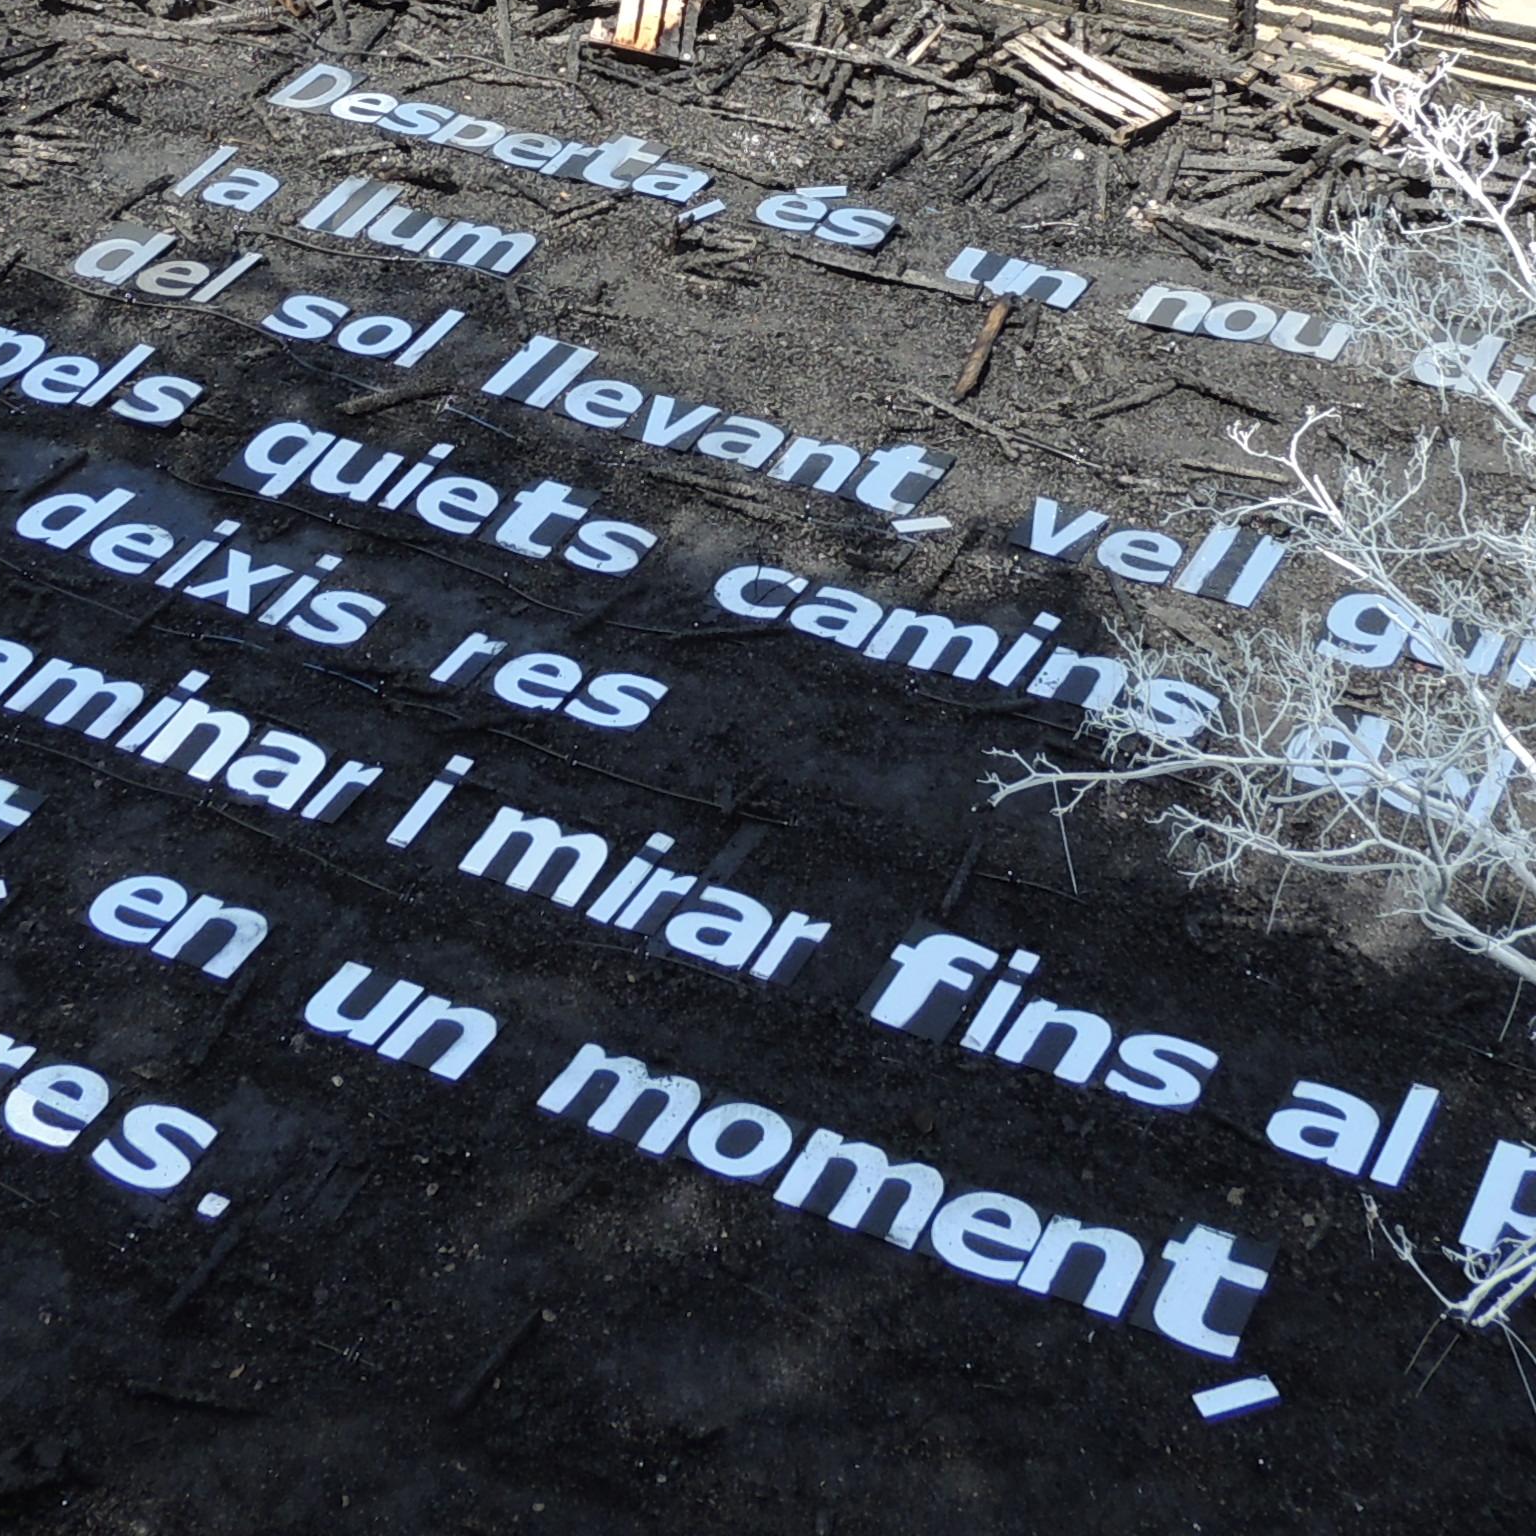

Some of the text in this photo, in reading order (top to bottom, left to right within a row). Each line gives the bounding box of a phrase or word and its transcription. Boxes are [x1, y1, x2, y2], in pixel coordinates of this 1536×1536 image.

[173, 144, 540, 276] la llum
[268, 63, 725, 224] Desperta,
[755, 186, 898, 249] és
[944, 246, 1092, 309] un
[1128, 283, 1352, 362] nou
[15, 487, 387, 646] deixis
[429, 630, 669, 730] res
[74, 229, 263, 303] del
[263, 293, 465, 368] sol
[482, 335, 952, 534] llevant,
[1028, 495, 1290, 609] vell
[242, 420, 658, 577] quiets
[713, 564, 1220, 739] camins
[1287, 713, 1518, 828] del
[87, 875, 269, 979] en
[303, 960, 498, 1081] un
[536, 1043, 1281, 1418] moment,
[385, 755, 474, 847] i
[459, 805, 831, 980] mirar
[870, 933, 1219, 1110] fins
[1266, 1080, 1440, 1186] al
